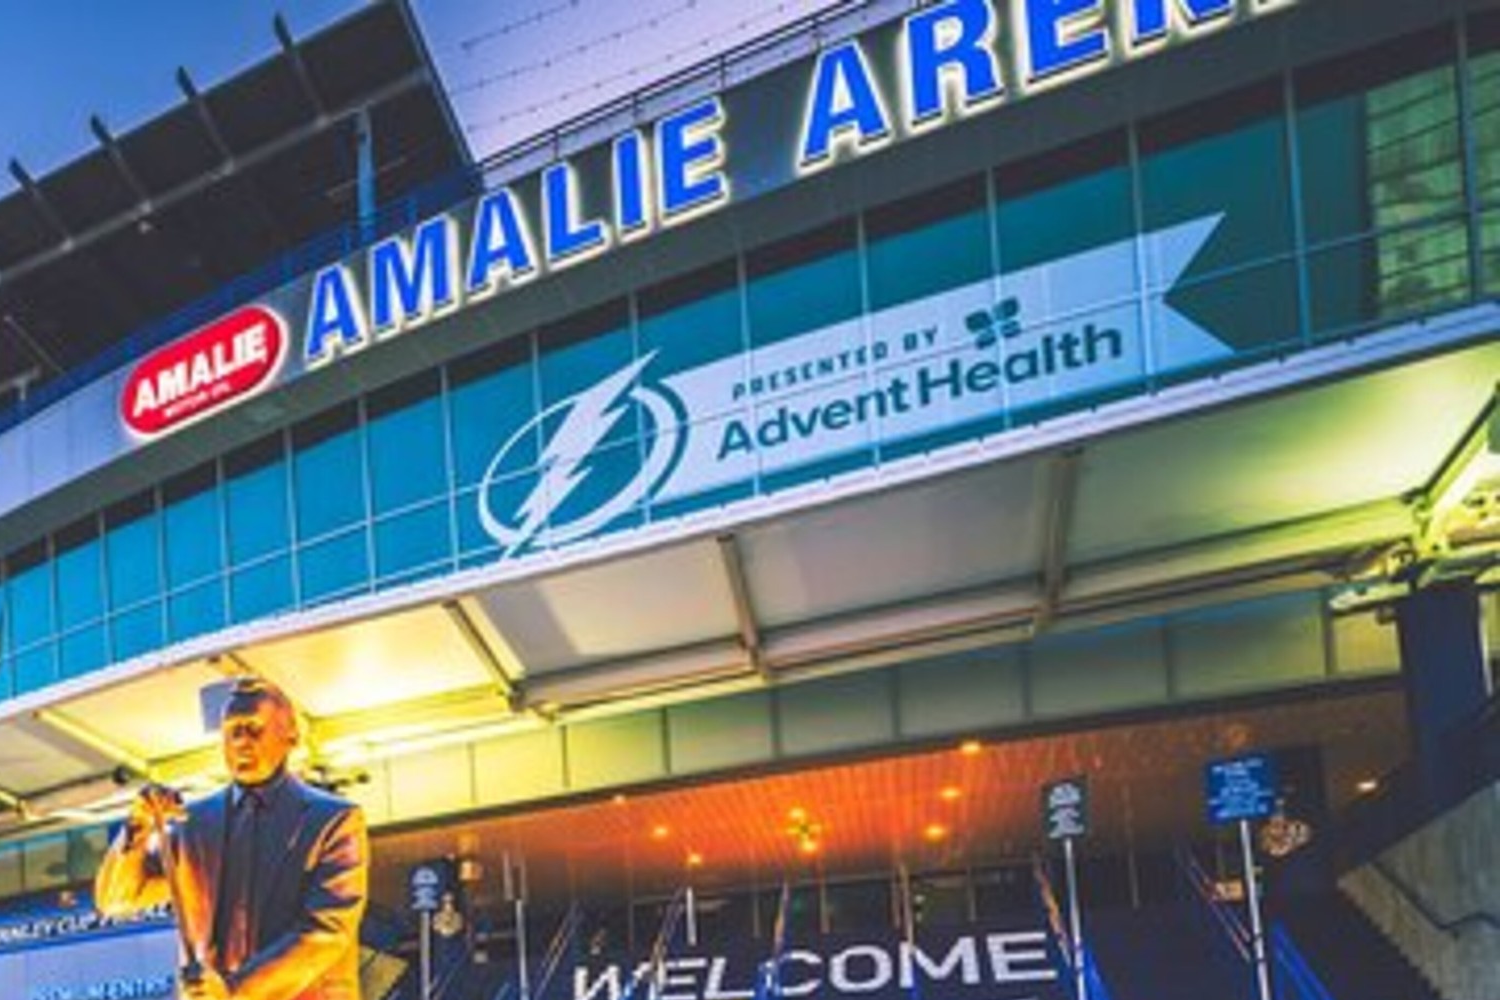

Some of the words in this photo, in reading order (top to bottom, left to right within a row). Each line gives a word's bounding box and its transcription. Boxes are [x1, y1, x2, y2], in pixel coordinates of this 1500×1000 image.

[304, 96, 730, 372] AMALIE
[132, 321, 267, 418] AMALIE
[716, 323, 1122, 461] AdventHealth
[732, 340, 888, 400] PRESENTED
[903, 325, 939, 354] BY
